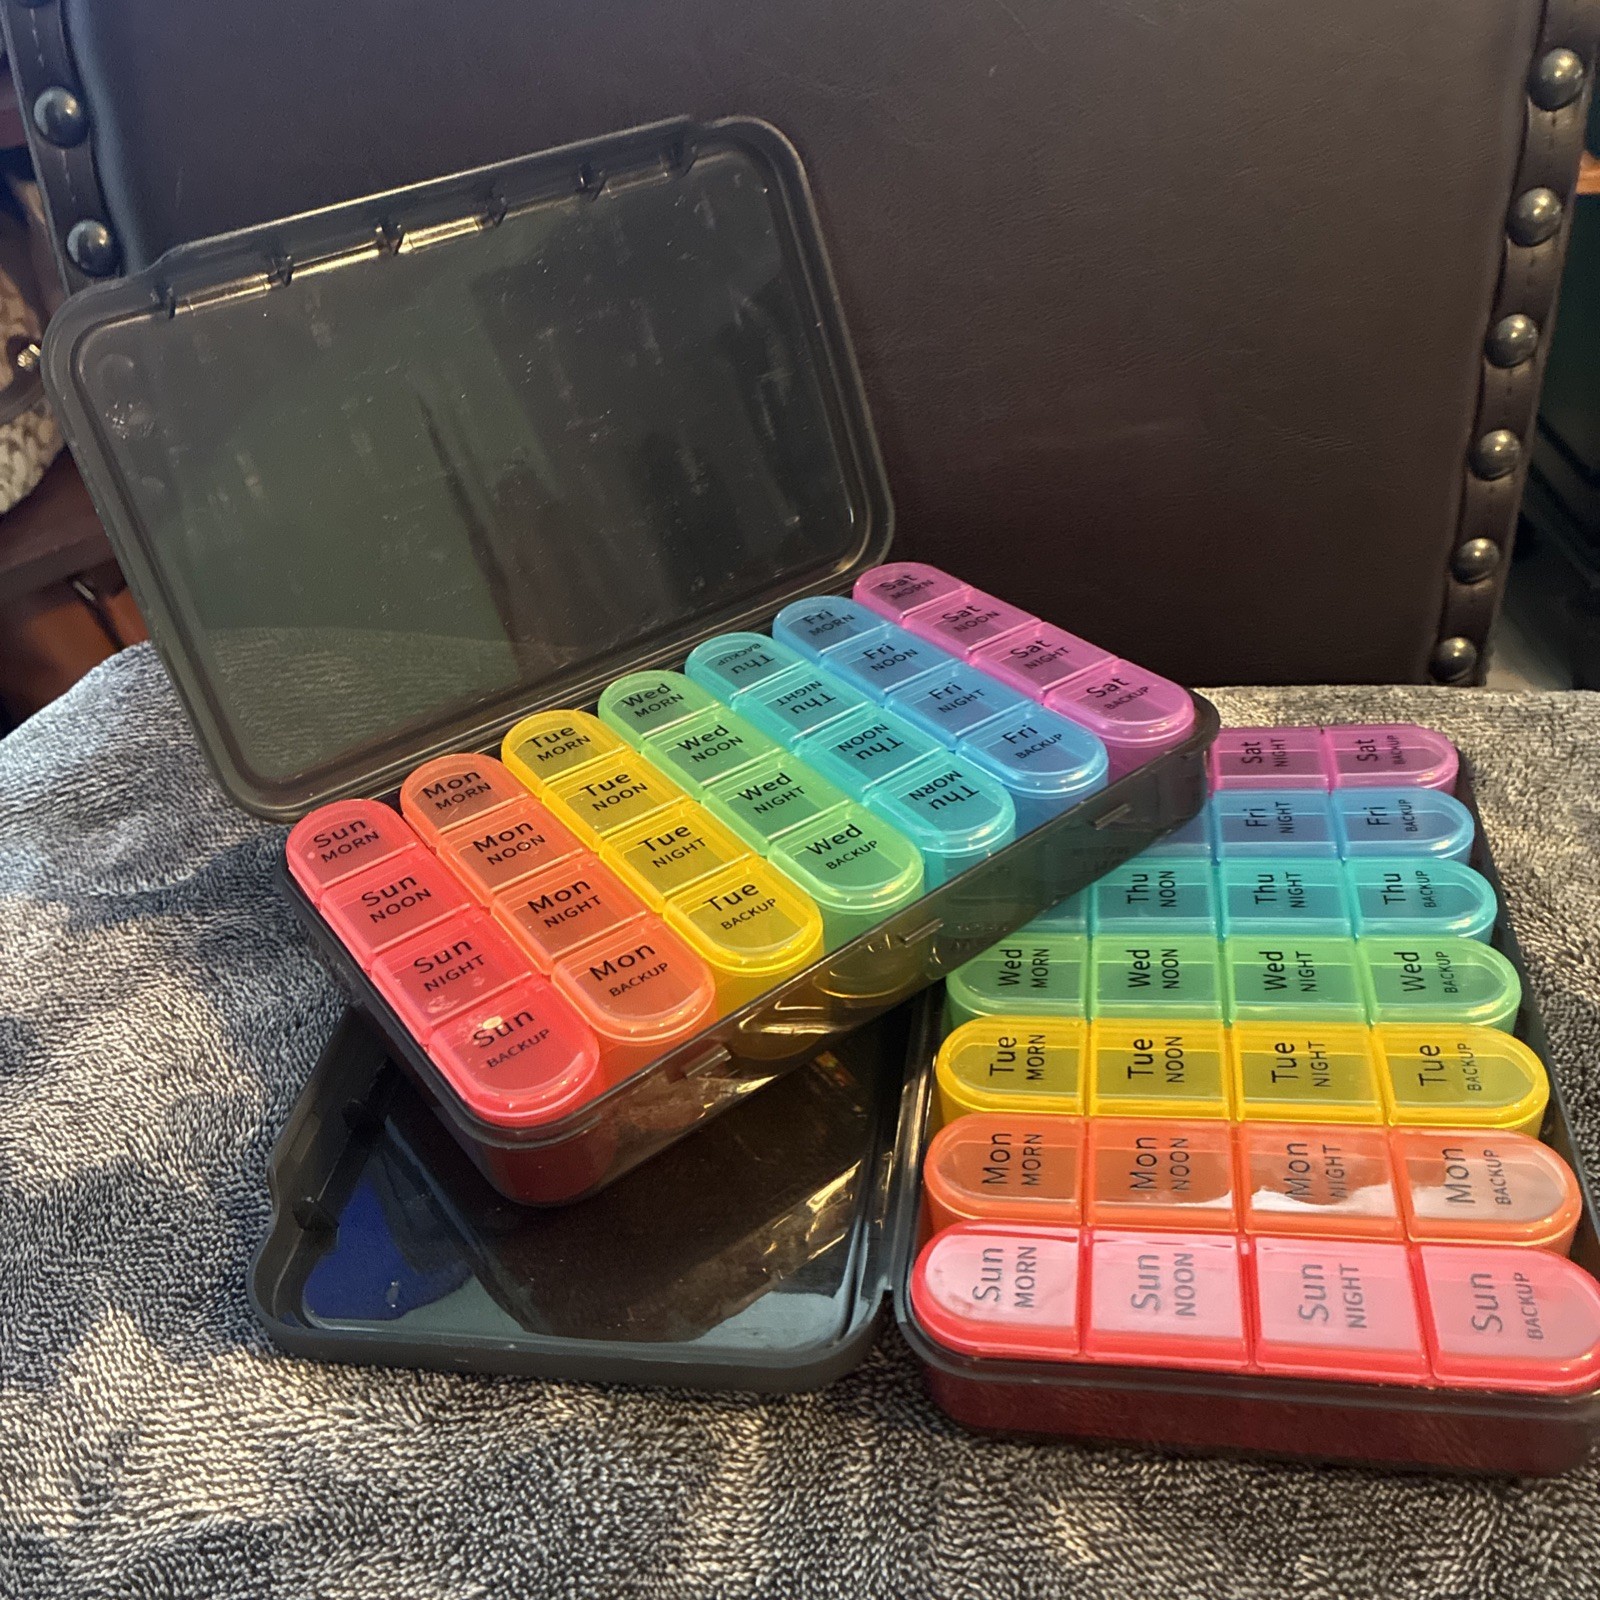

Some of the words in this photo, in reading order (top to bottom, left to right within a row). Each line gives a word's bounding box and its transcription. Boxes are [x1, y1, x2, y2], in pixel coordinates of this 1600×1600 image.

[880, 574, 918, 591] Sat
[891, 579, 934, 600] MORN
[803, 609, 834, 626] Fri
[809, 614, 856, 637] MORN
[941, 604, 982, 624] Sat
[954, 610, 1000, 632] NOON
[718, 643, 762, 666] BACKUP
[731, 653, 774, 674] Thu
[863, 643, 896, 660] Fri
[870, 648, 918, 672] NOON
[1010, 639, 1052, 660] Sat
[1024, 646, 1070, 670] NIGHT
[621, 683, 672, 708] Wed
[777, 681, 822, 707] NIGHT
[929, 682, 962, 702] Fri
[938, 689, 986, 714] NIGHT
[1086, 676, 1130, 699] Sat
[1103, 686, 1149, 710] BACKUP
[634, 693, 684, 718] MORN
[791, 693, 837, 715] Thu
[526, 725, 576, 749] Tue
[536, 735, 591, 762] MORN
[677, 725, 730, 751] Wed
[692, 736, 744, 762] NOON
[838, 723, 889, 752] NOON
[856, 737, 904, 760] Thu
[1001, 725, 1038, 745] Fri
[1015, 733, 1063, 760] BACKUP
[1356, 738, 1378, 762] Sat
[1387, 735, 1406, 765] BACKUP
[1241, 741, 1263, 764] Sat
[1270, 738, 1288, 767] NIGHT
[422, 770, 481, 800] Mon
[435, 782, 492, 810] MORN
[579, 772, 632, 798] Tue
[592, 783, 648, 812] NOON
[738, 773, 792, 802] Wed
[753, 786, 806, 814] NIGHT
[908, 770, 963, 801] MORN
[930, 785, 980, 810] Thu
[1243, 807, 1268, 828] Fri
[1274, 801, 1294, 834] NIGHT
[1366, 806, 1390, 826] Fri
[1398, 799, 1418, 832] BACKUP
[313, 819, 367, 848] Sun
[321, 831, 380, 863] MORN
[472, 821, 534, 853] Mon
[486, 834, 546, 865] NOON
[637, 825, 692, 852] Tue
[805, 823, 862, 856] Wed
[652, 837, 707, 868] NIGHT
[826, 840, 878, 870] BACKUP
[361, 875, 417, 907] Sun
[527, 879, 591, 914] Mon
[703, 883, 759, 913] Tue
[1125, 873, 1149, 904] Thu
[1159, 870, 1177, 908] NOON
[1253, 873, 1277, 905] Thu
[1286, 872, 1305, 909] NIGHT
[1380, 872, 1406, 905] Thu
[1415, 870, 1437, 907] BACKUP
[369, 888, 432, 923] NOON
[543, 895, 601, 928] NIGHT
[721, 898, 777, 930] BACKUP
[413, 940, 473, 974] Sun
[423, 954, 485, 992] NIGHT
[589, 943, 656, 982] Mon
[997, 949, 1023, 986] Wed
[1030, 948, 1050, 989] MORN
[1127, 950, 1150, 988] Wed
[1161, 948, 1180, 989] NOON
[1259, 950, 1288, 991] Wed
[1296, 950, 1318, 992] NIGHT
[1393, 952, 1426, 992] Wed
[1436, 951, 1459, 993] BACKUP
[609, 962, 669, 997] BACKUP
[473, 1010, 535, 1048] Sun
[486, 1028, 550, 1068] BACKUP
[989, 1036, 1017, 1076] Tue
[1026, 1034, 1046, 1080] MORN
[1127, 1038, 1154, 1079] Tue
[1165, 1036, 1185, 1083] NOON
[1271, 1042, 1299, 1083] Tue
[1307, 1040, 1331, 1088] NIGHT
[1418, 1044, 1447, 1086] Tue
[1457, 1043, 1482, 1092] BACKUP
[982, 1133, 1012, 1186] Mon
[1022, 1134, 1044, 1186] MORN
[1129, 1137, 1158, 1191] Mon
[1170, 1138, 1190, 1190] NOON
[1283, 1142, 1312, 1199] Mon
[1322, 1144, 1349, 1199] NIGHT
[1443, 1147, 1476, 1204] Mon
[1483, 1149, 1512, 1205] BACKUP
[972, 1247, 1004, 1302] Sun
[1014, 1246, 1038, 1308] MORN
[1131, 1254, 1160, 1312] Sun
[1173, 1253, 1196, 1317] NOON
[1298, 1263, 1330, 1324] Sun
[1339, 1263, 1367, 1329] NIGHT
[1472, 1272, 1503, 1333] Sun
[1512, 1272, 1544, 1340] BACKUP
